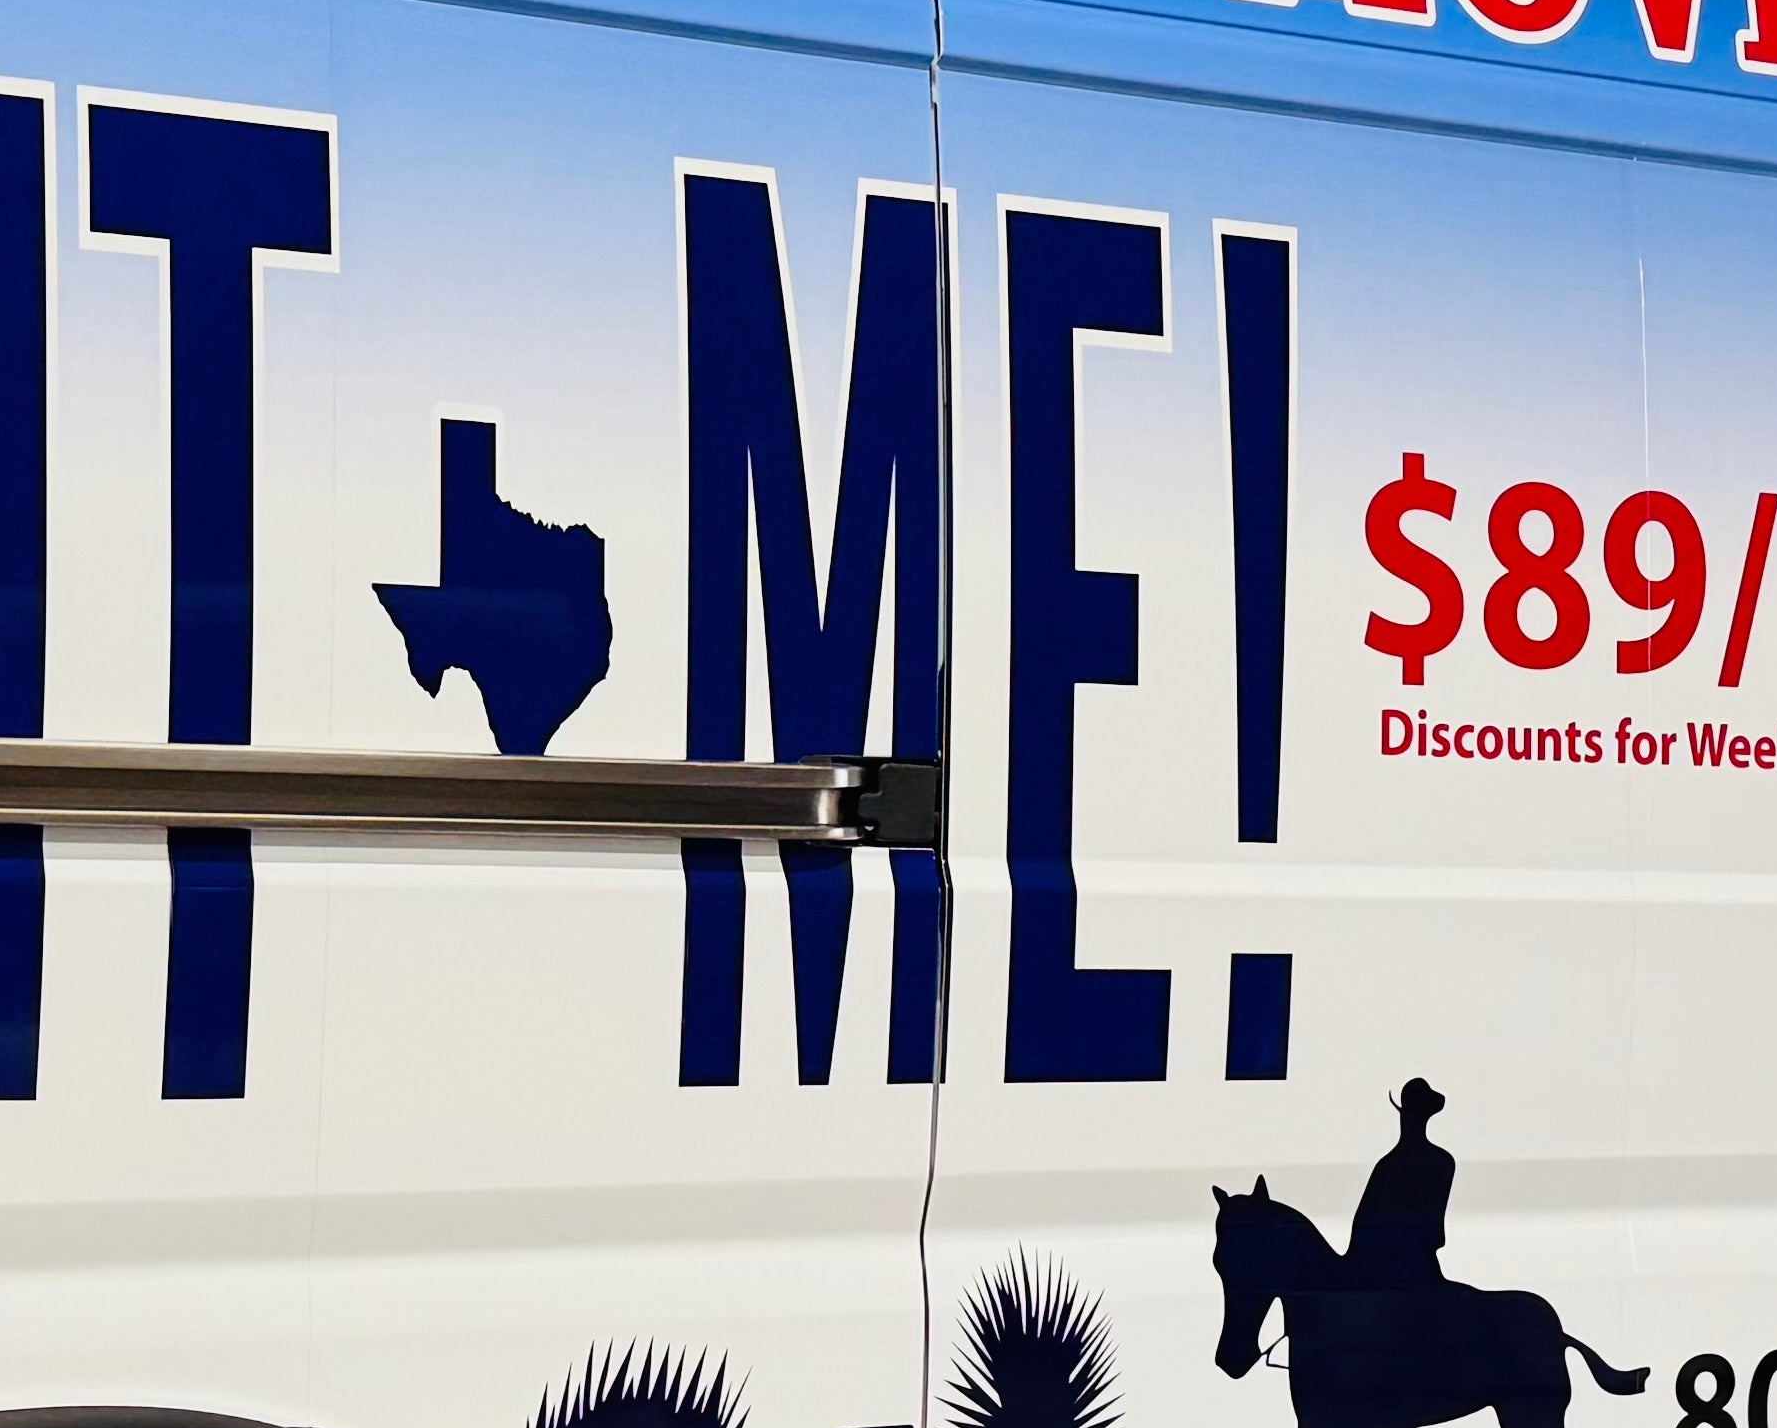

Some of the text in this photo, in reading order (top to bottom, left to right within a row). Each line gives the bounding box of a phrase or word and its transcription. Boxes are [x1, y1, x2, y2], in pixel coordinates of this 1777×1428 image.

[674, 163, 1294, 1088] ME!
[1379, 708, 1605, 765] Discounts
[1614, 717, 1678, 767] for
